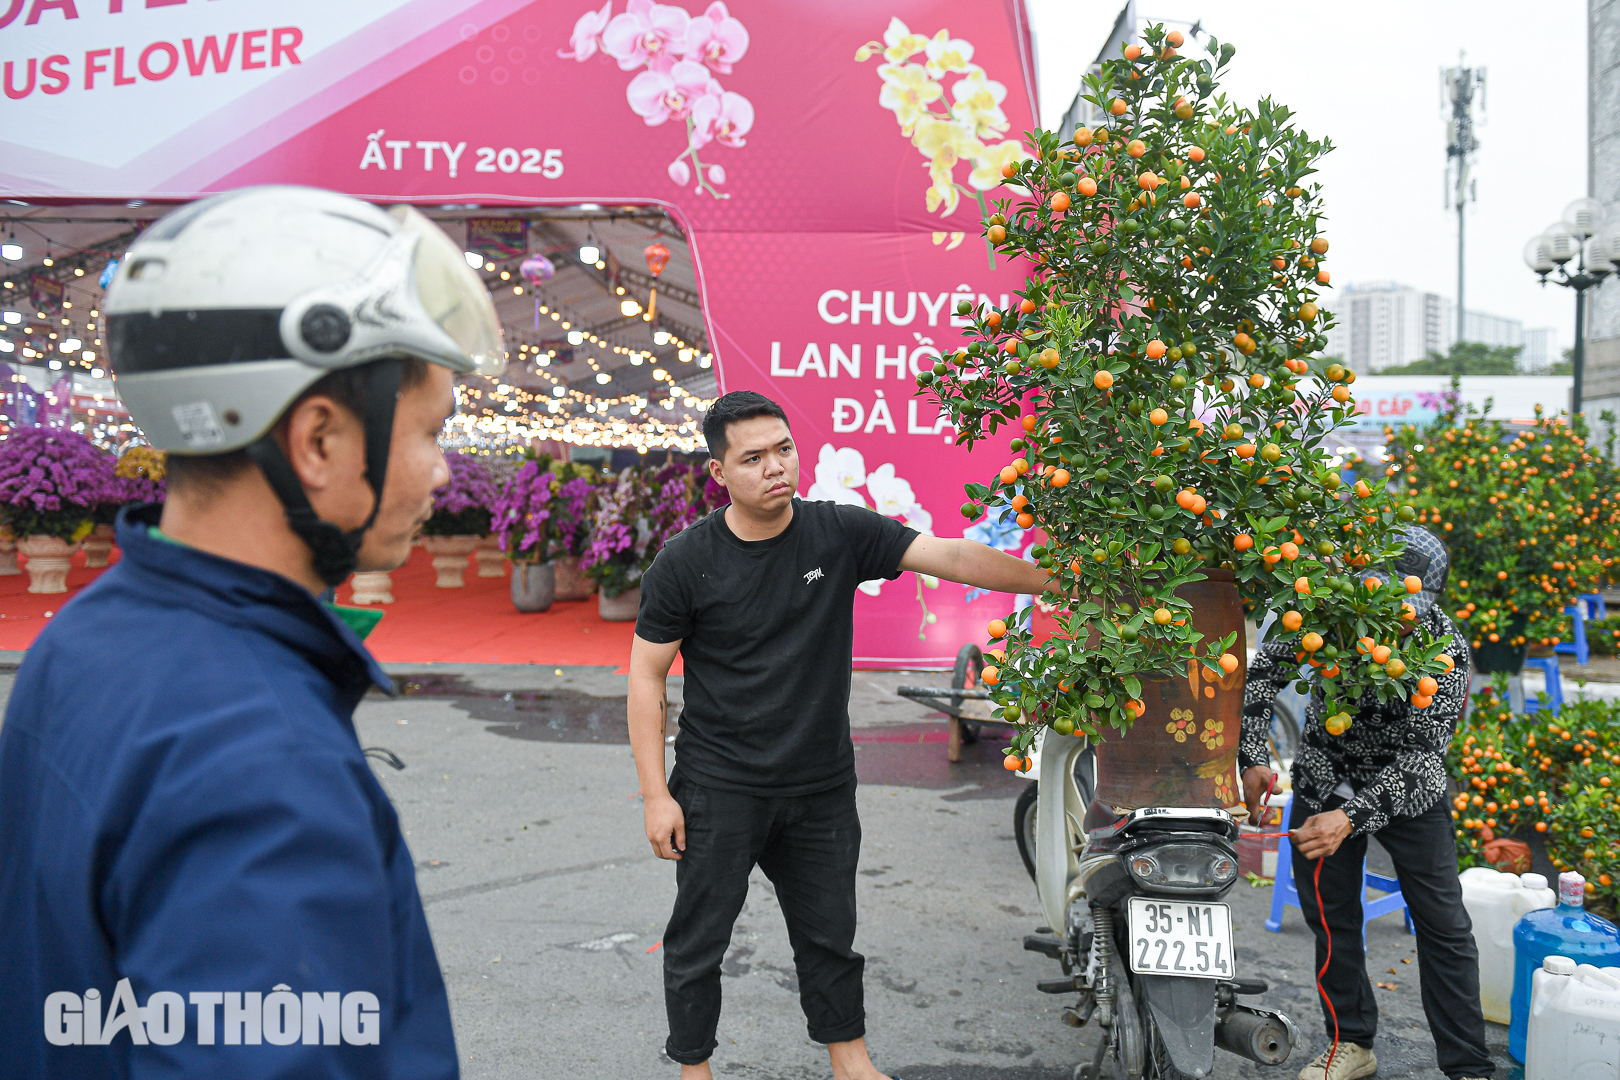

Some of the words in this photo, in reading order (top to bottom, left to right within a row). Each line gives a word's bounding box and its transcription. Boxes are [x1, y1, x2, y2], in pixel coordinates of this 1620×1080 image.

[3, 54, 70, 100] US
[83, 26, 303, 90] FLOWER
[359, 128, 411, 171] ẤT
[416, 140, 467, 178] TỴ
[475, 147, 564, 179] 2025
[770, 341, 861, 379] LAN
[831, 389, 896, 434] ĐÀ
[1145, 904, 1213, 937] 35-N1
[1137, 938, 1227, 974] 222.54
